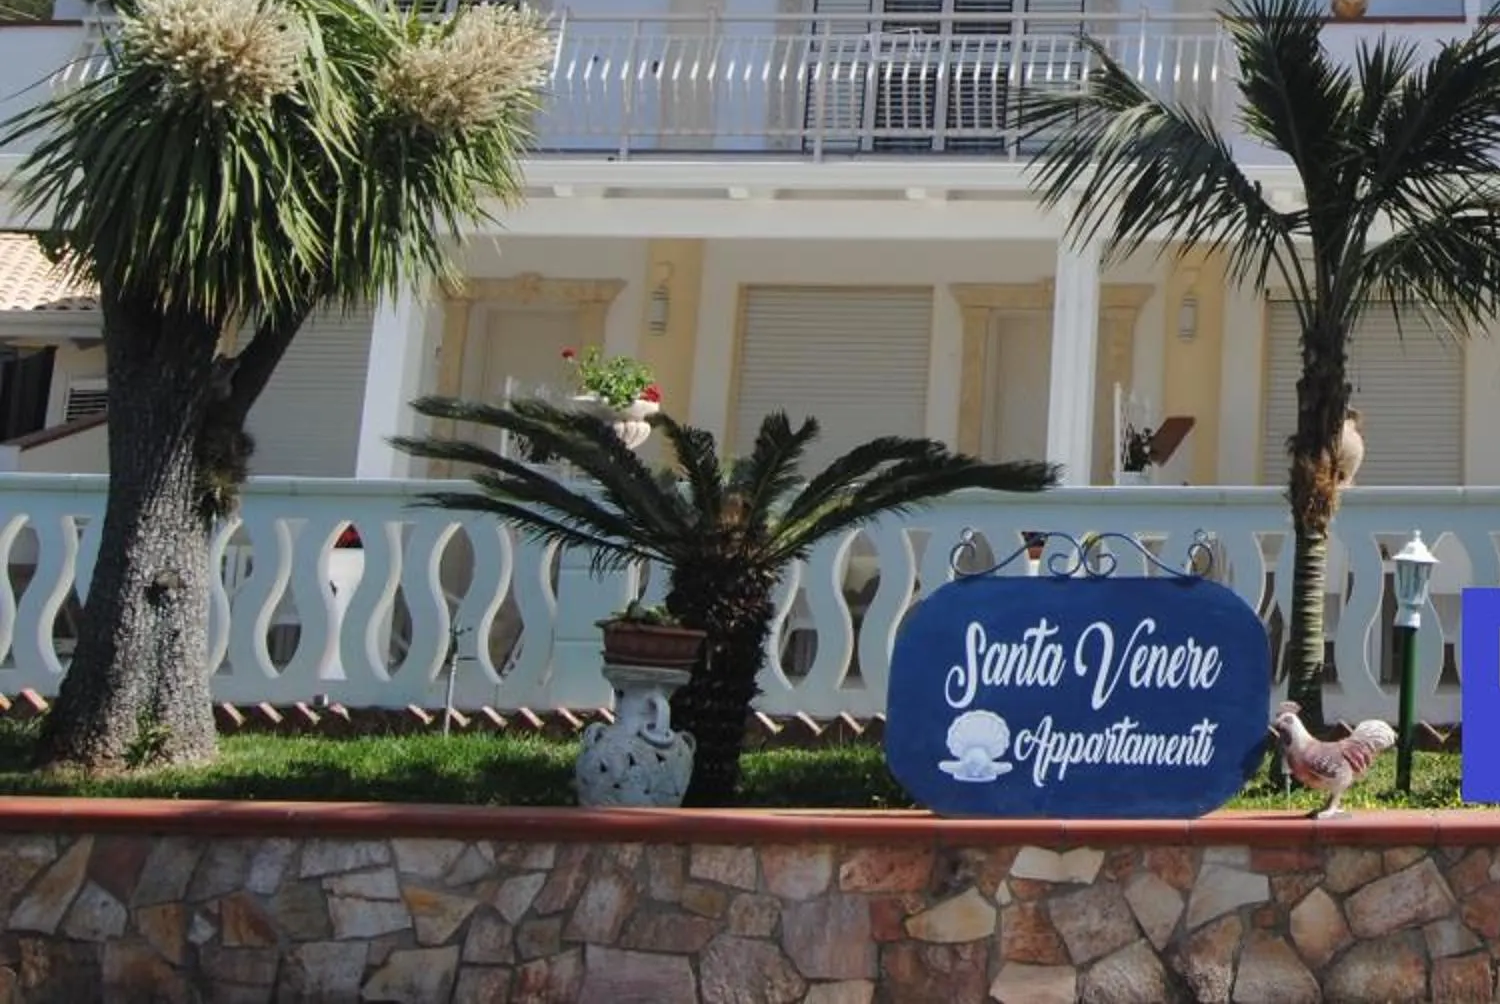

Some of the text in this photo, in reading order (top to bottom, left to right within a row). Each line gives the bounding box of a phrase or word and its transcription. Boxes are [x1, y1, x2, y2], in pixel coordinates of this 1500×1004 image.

[945, 617, 1222, 710] Santa Venere
[1014, 715, 1218, 788] Appartamenti
